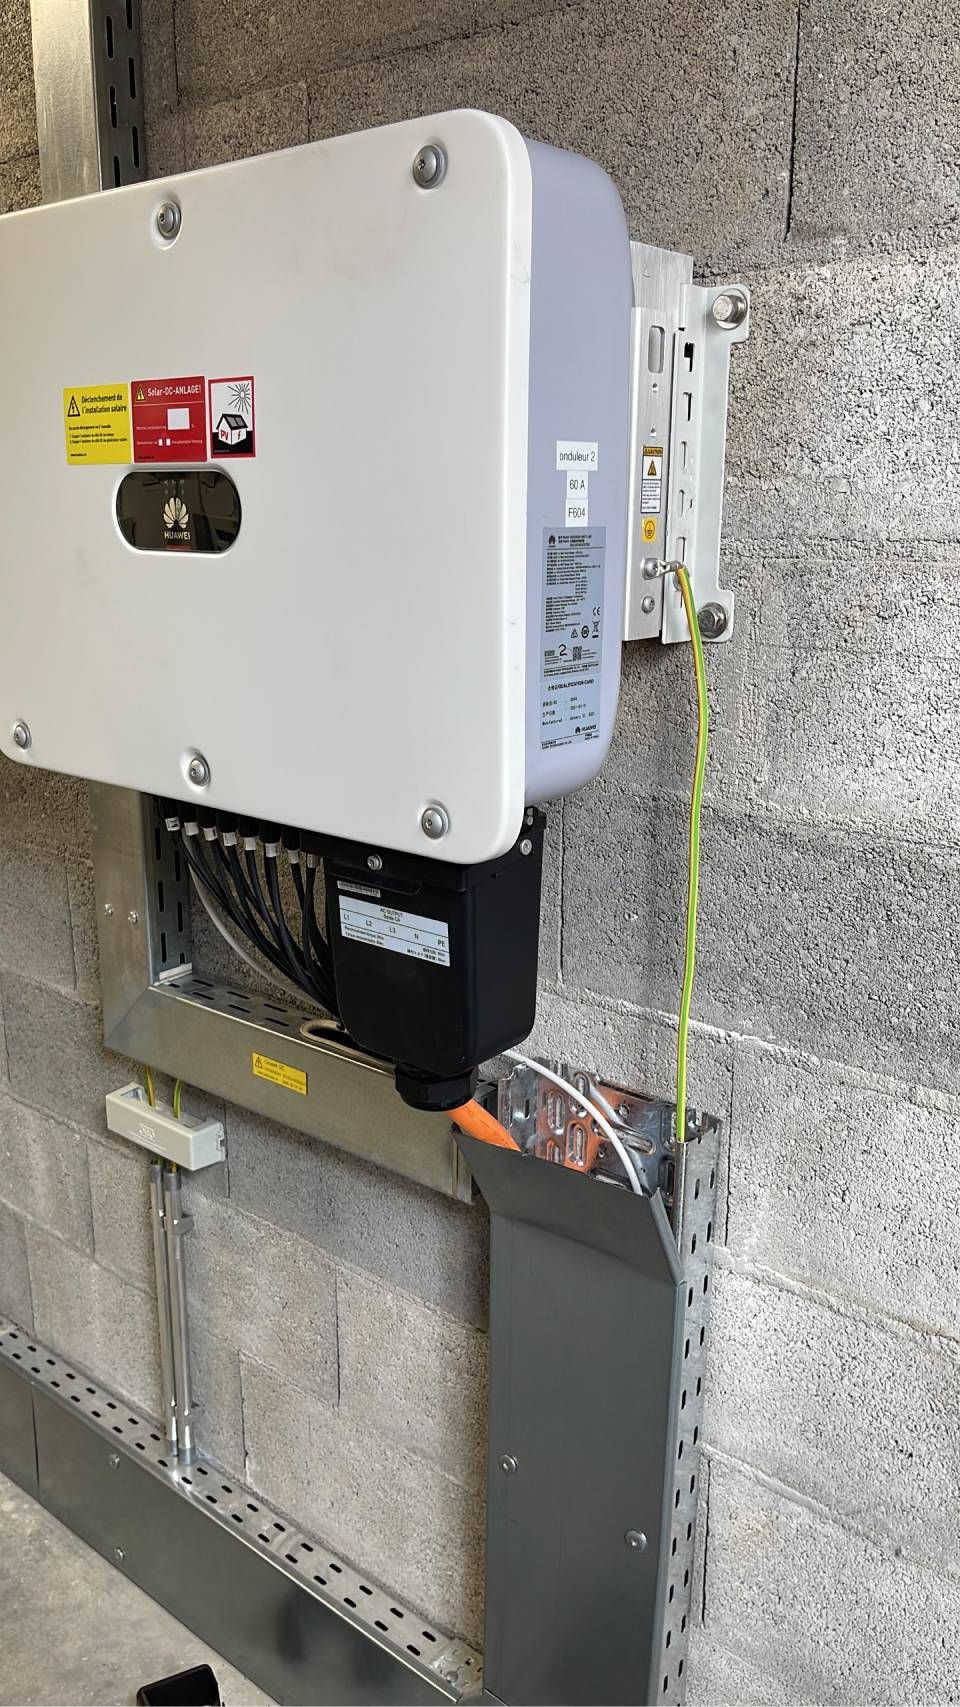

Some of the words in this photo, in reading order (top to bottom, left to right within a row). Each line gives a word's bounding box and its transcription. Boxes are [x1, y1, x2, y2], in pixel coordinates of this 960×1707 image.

[147, 384, 202, 397] Solar-DC-ANLAGE!
[116, 393, 123, 401] de
[111, 404, 127, 413] solaire
[220, 430, 229, 441] PV
[559, 450, 589, 462] onduleur
[590, 450, 596, 462] 2
[569, 479, 579, 491] 60
[580, 479, 586, 491] A
[568, 507, 586, 518] F604
[164, 531, 191, 540] HUAWEI
[380, 907, 387, 915] AC
[387, 908, 403, 918] OUTPUT
[343, 913, 350, 921] L1
[365, 919, 373, 927] L2
[437, 939, 445, 947] PE
